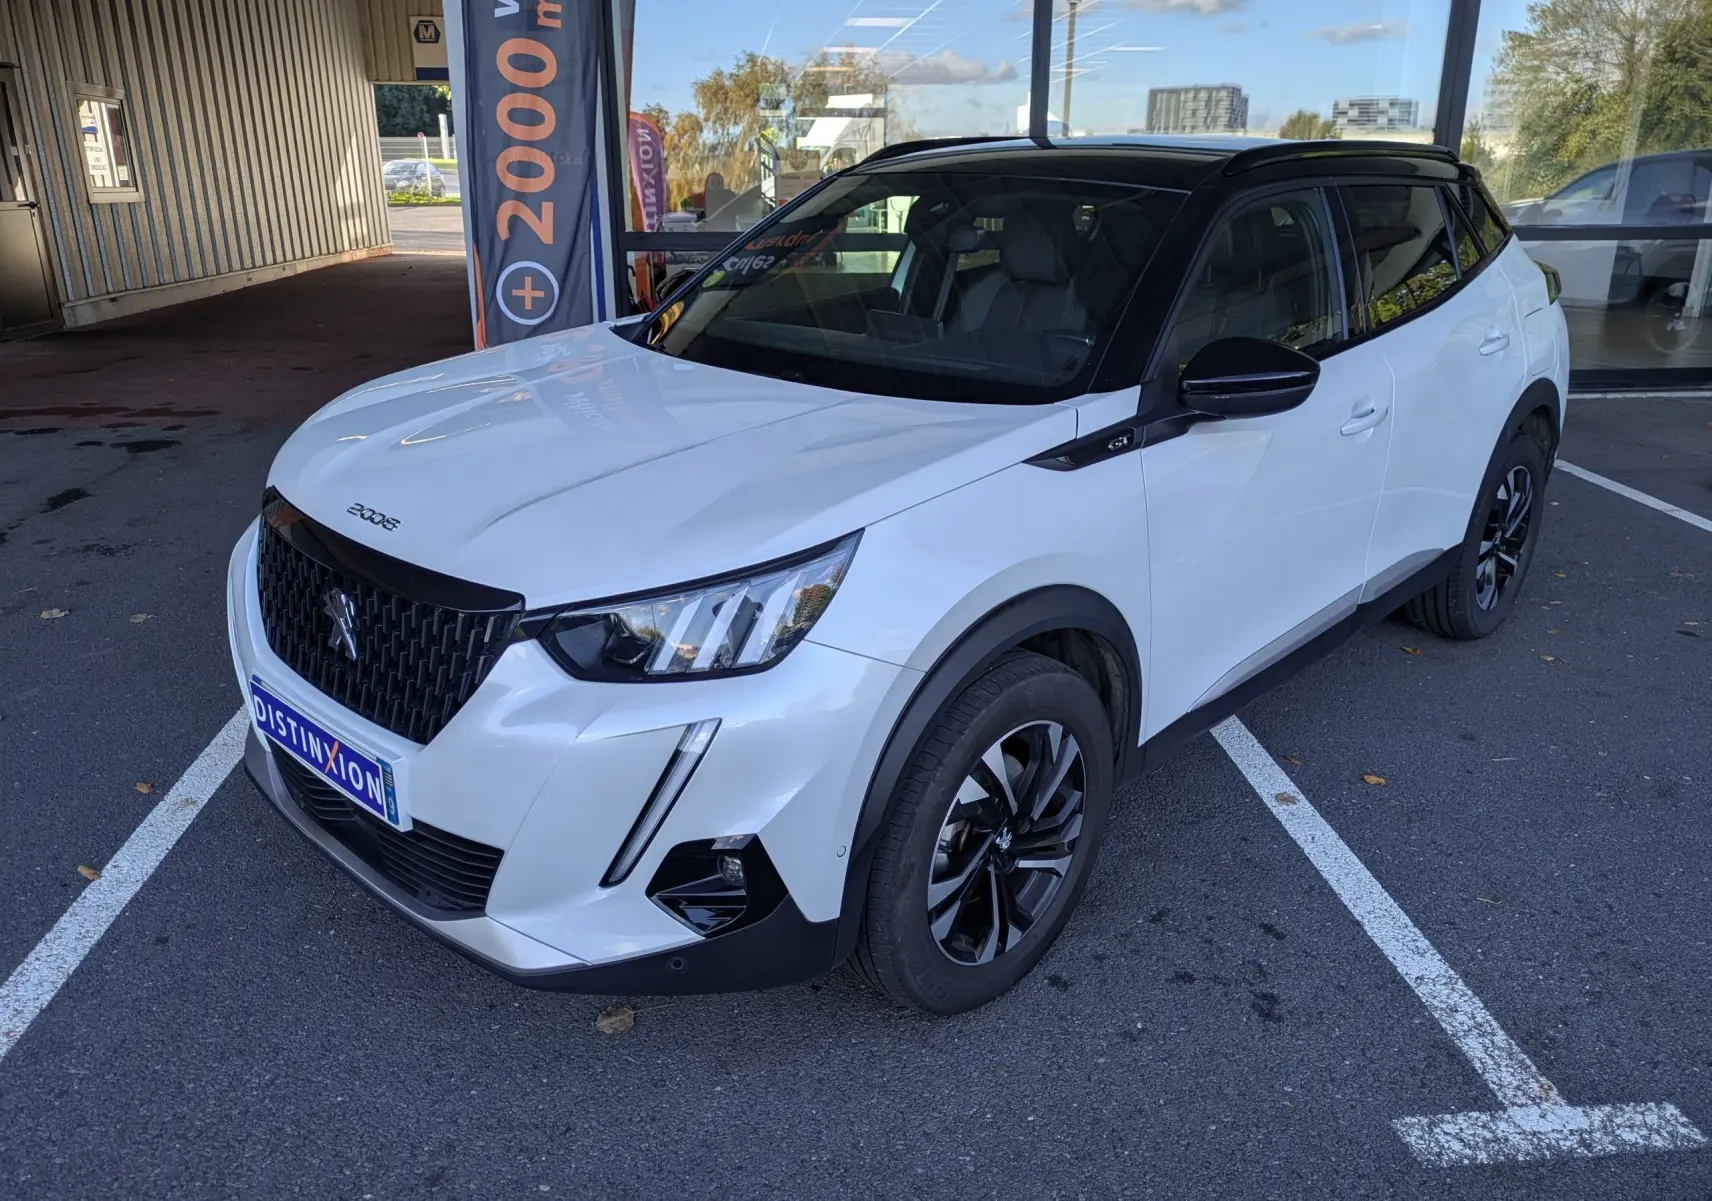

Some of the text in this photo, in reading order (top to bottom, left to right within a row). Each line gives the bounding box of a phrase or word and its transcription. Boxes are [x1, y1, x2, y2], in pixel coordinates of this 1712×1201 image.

[418, 22, 436, 41] M
[496, 37, 558, 245] 2000
[1107, 434, 1131, 450] GT
[346, 502, 401, 532] 2008
[253, 694, 383, 806] DISTINXION
